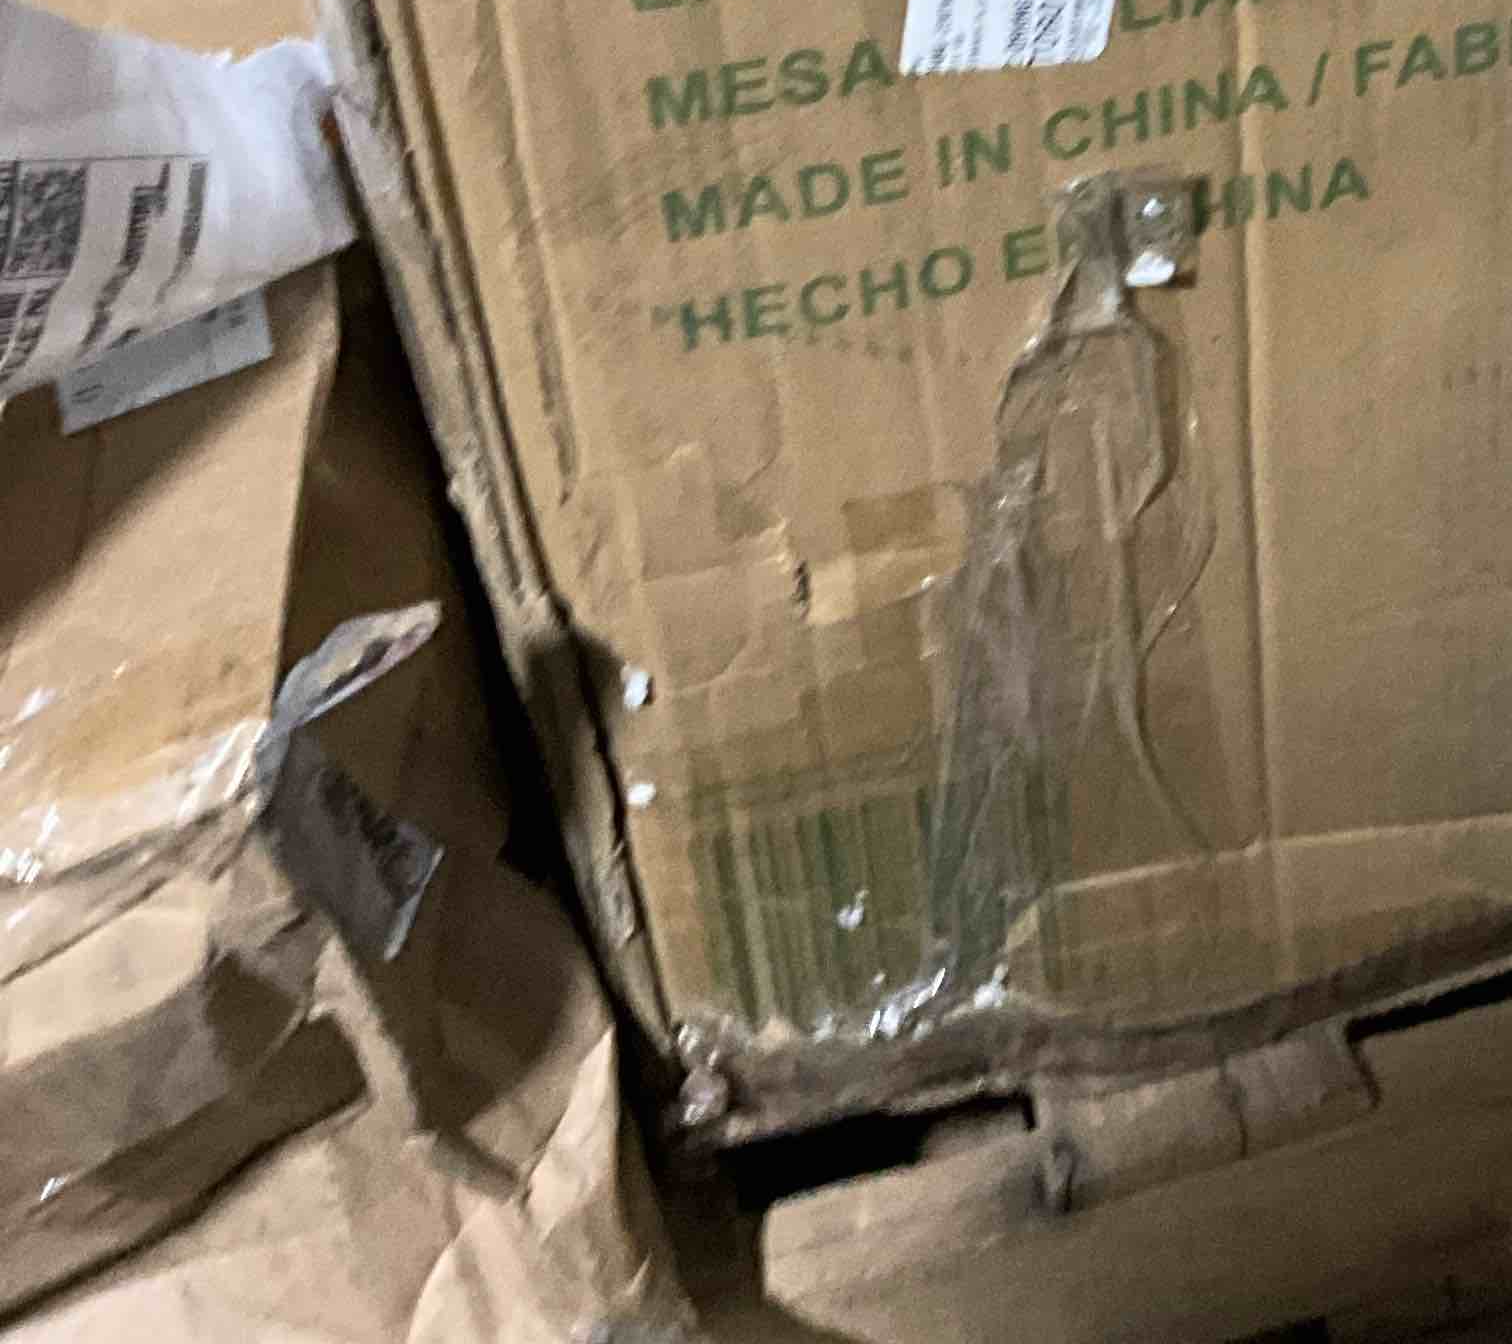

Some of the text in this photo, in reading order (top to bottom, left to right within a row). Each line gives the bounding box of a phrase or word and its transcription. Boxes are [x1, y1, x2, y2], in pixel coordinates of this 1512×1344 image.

[646, 39, 895, 130] MESA
[660, 148, 911, 243] MADE
[938, 130, 1012, 190] IN
[1043, 68, 1290, 162] CHINA
[680, 157, 1371, 352] HECHO E HINA
